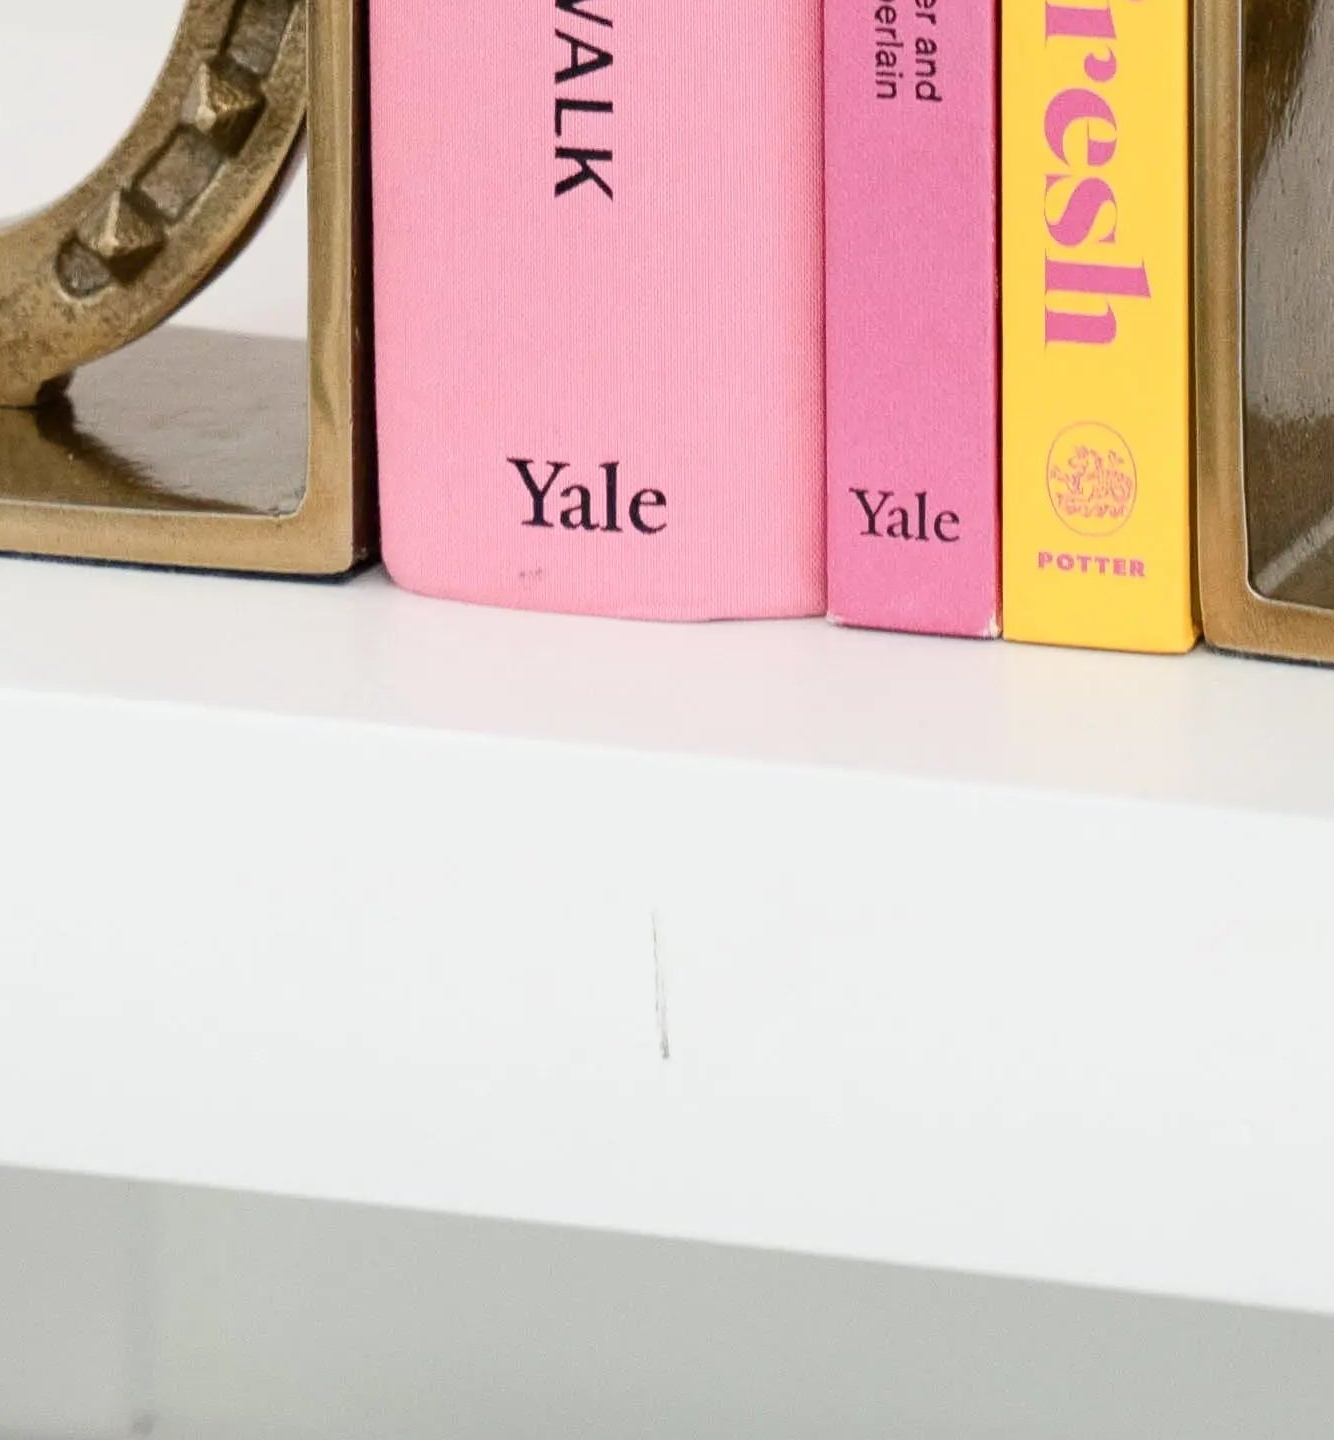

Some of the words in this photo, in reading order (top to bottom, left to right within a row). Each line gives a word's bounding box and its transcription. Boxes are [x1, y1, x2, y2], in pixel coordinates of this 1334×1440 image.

[914, 36, 943, 103] and
[506, 457, 668, 535] Yale
[848, 487, 960, 543] Yale
[1037, 549, 1146, 579] POTTER
